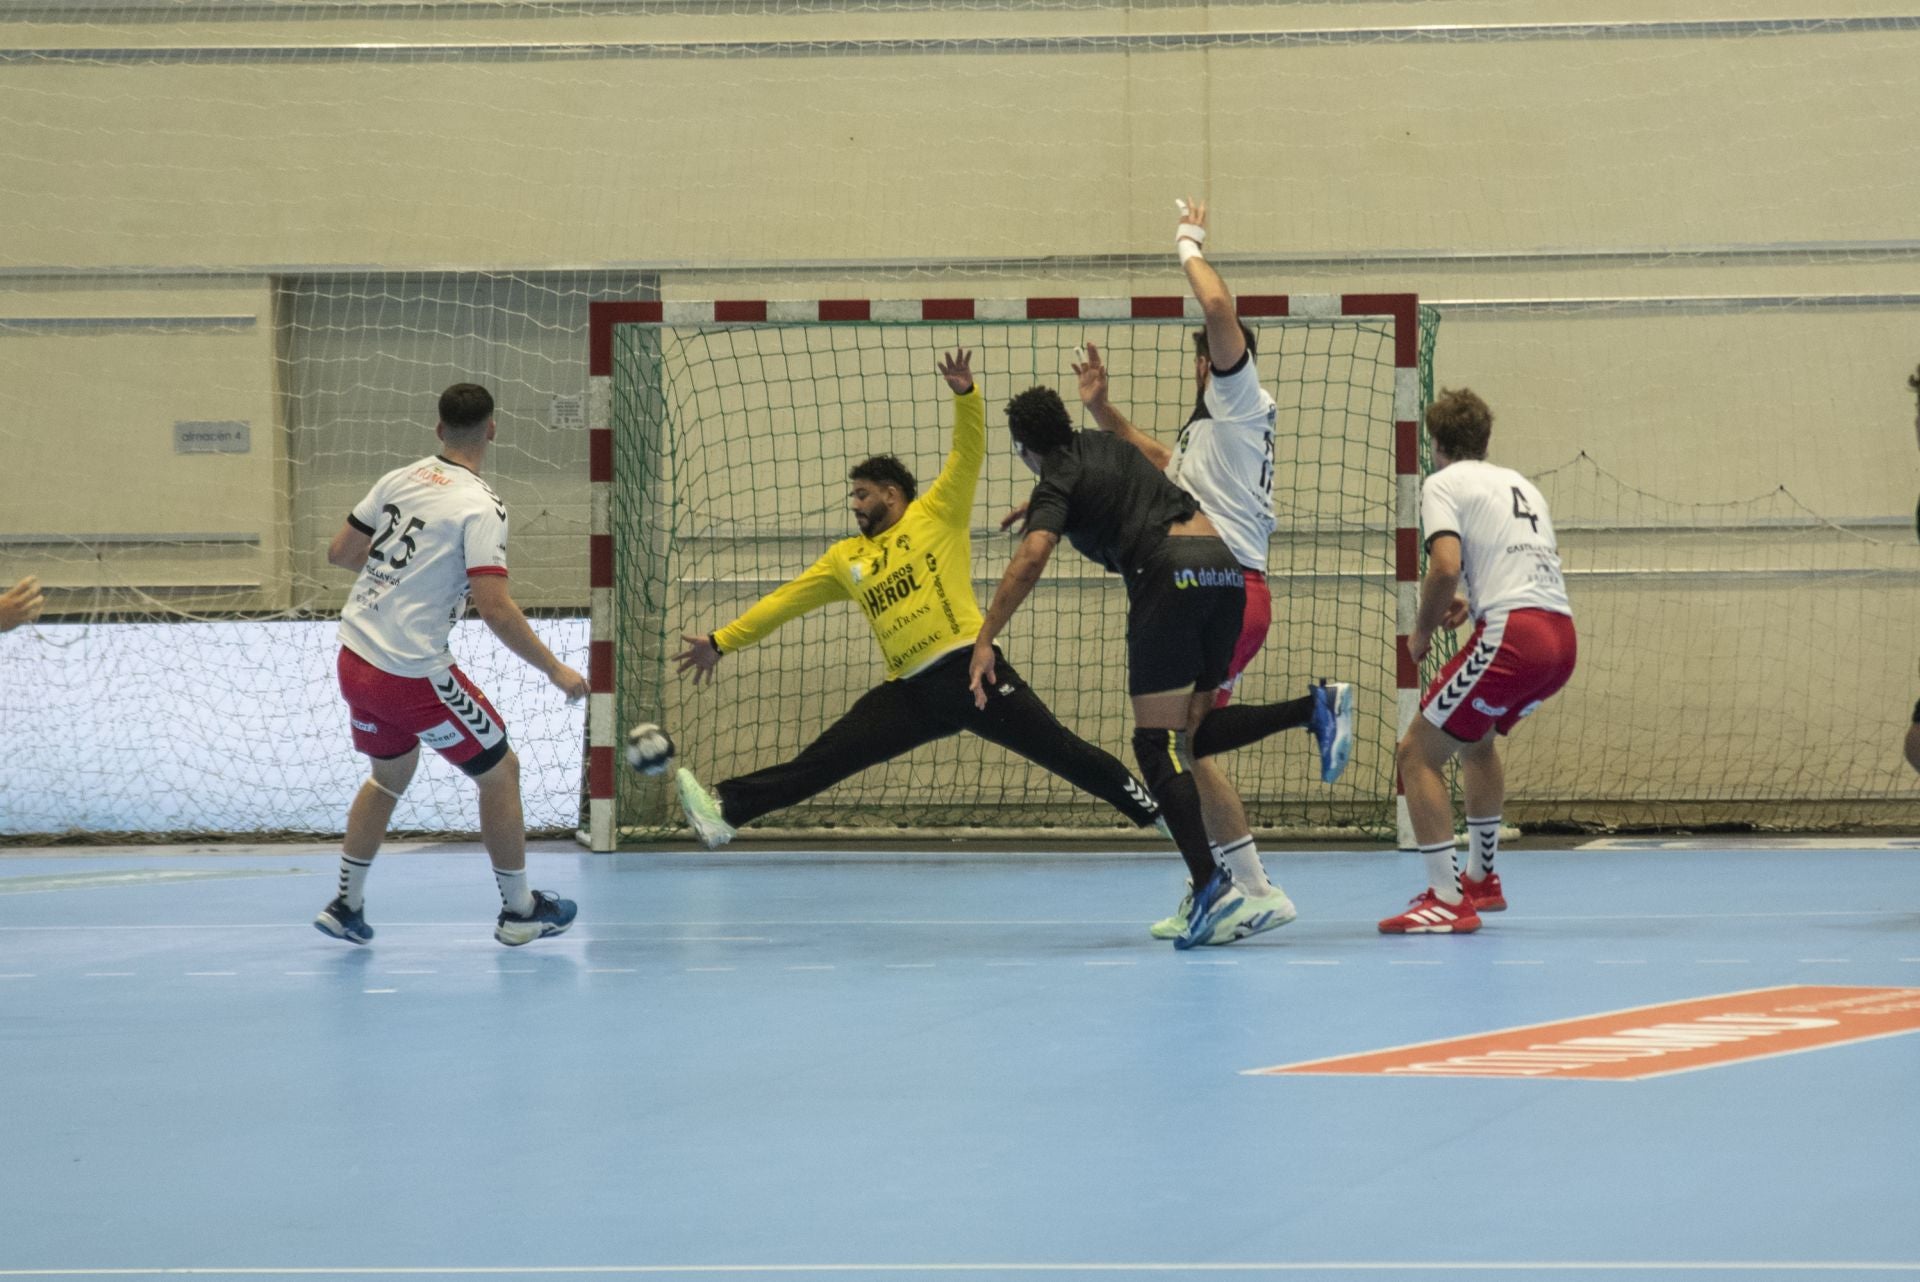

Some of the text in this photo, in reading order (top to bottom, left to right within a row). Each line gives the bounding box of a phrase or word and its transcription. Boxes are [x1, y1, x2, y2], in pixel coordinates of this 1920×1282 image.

[1510, 486, 1539, 534] 4
[368, 503, 426, 570] 25
[863, 574, 922, 620] HEROL
